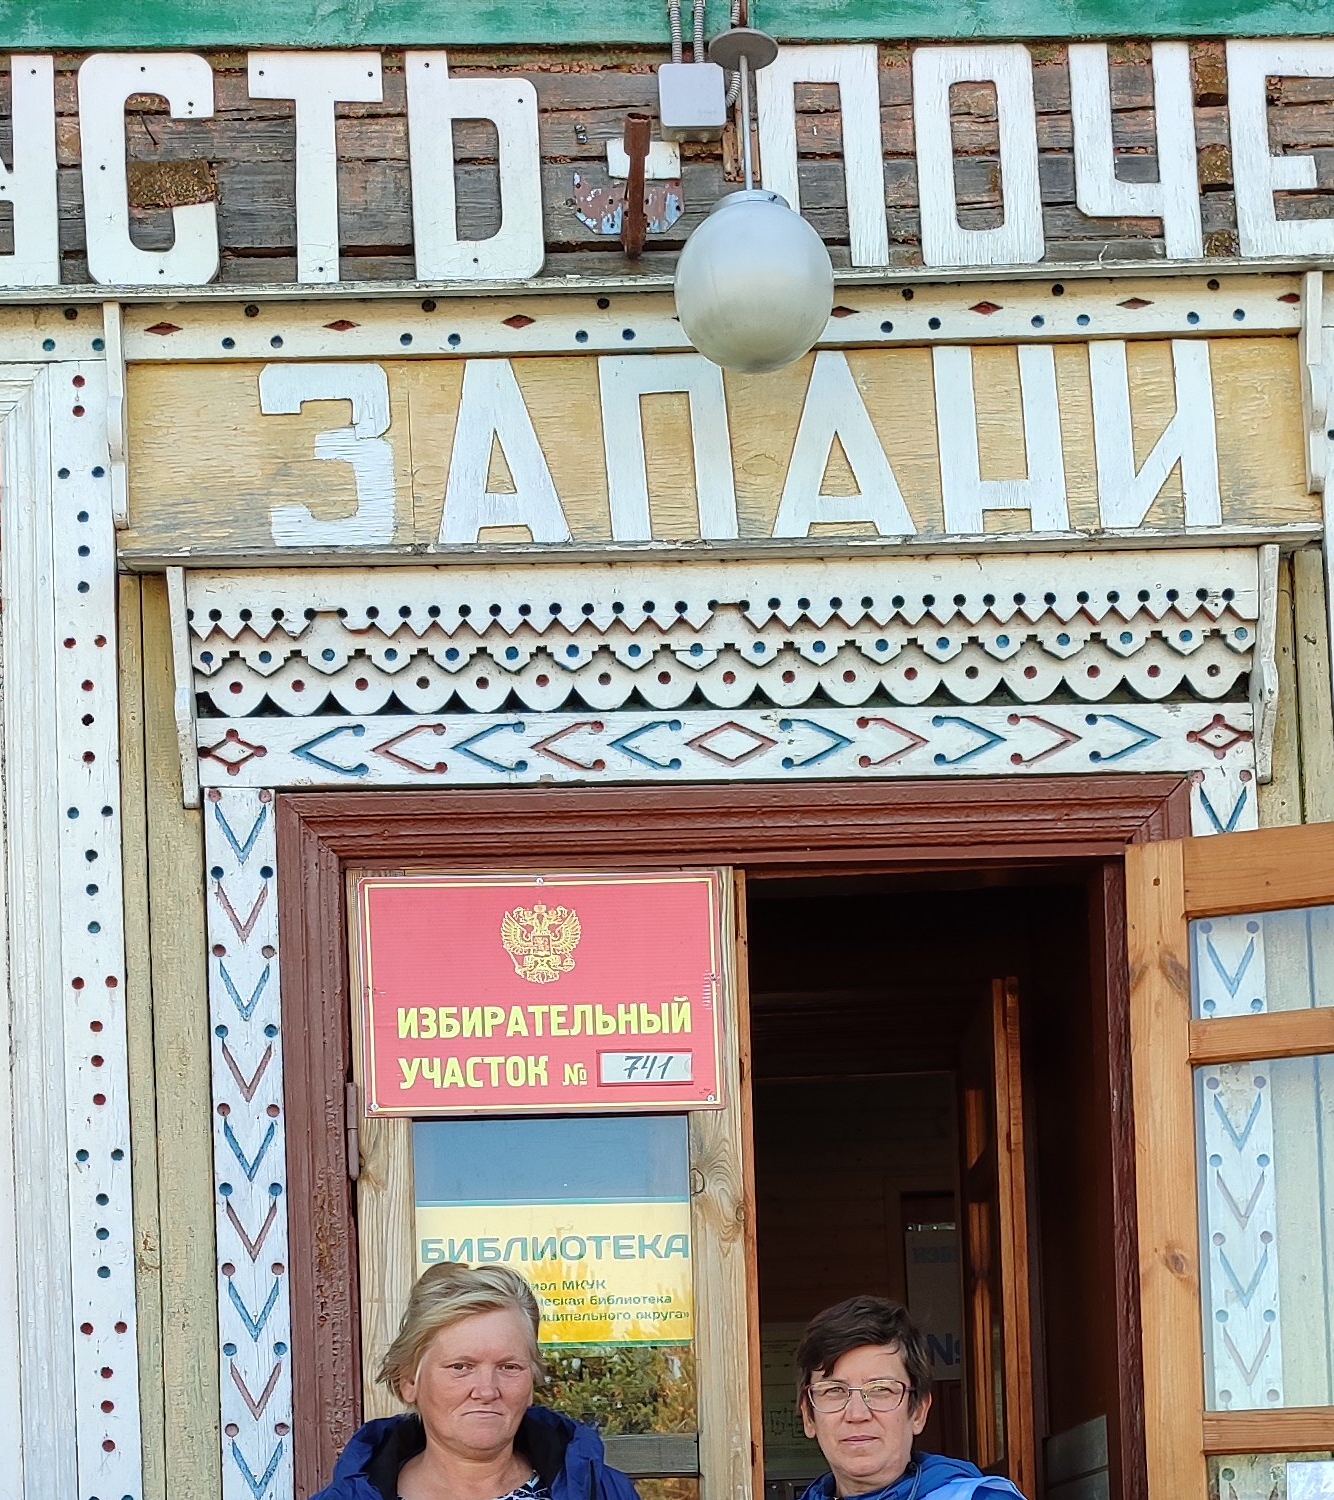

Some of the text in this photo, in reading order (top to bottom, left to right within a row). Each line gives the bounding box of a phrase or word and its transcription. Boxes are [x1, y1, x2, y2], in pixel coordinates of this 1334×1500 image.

[257, 339, 1221, 547] ЗАПАНИ
[397, 996, 692, 1039] ИЗБИРАТЕЛЬНЫЙ
[397, 1056, 549, 1089] УЧАСТОК
[623, 1055, 675, 1080] 741
[420, 1234, 689, 1264] БИБЛИОТЕКА
[530, 1279, 607, 1292] иал МКУК
[589, 1294, 672, 1306] библиотека
[539, 1308, 630, 1322] иципального
